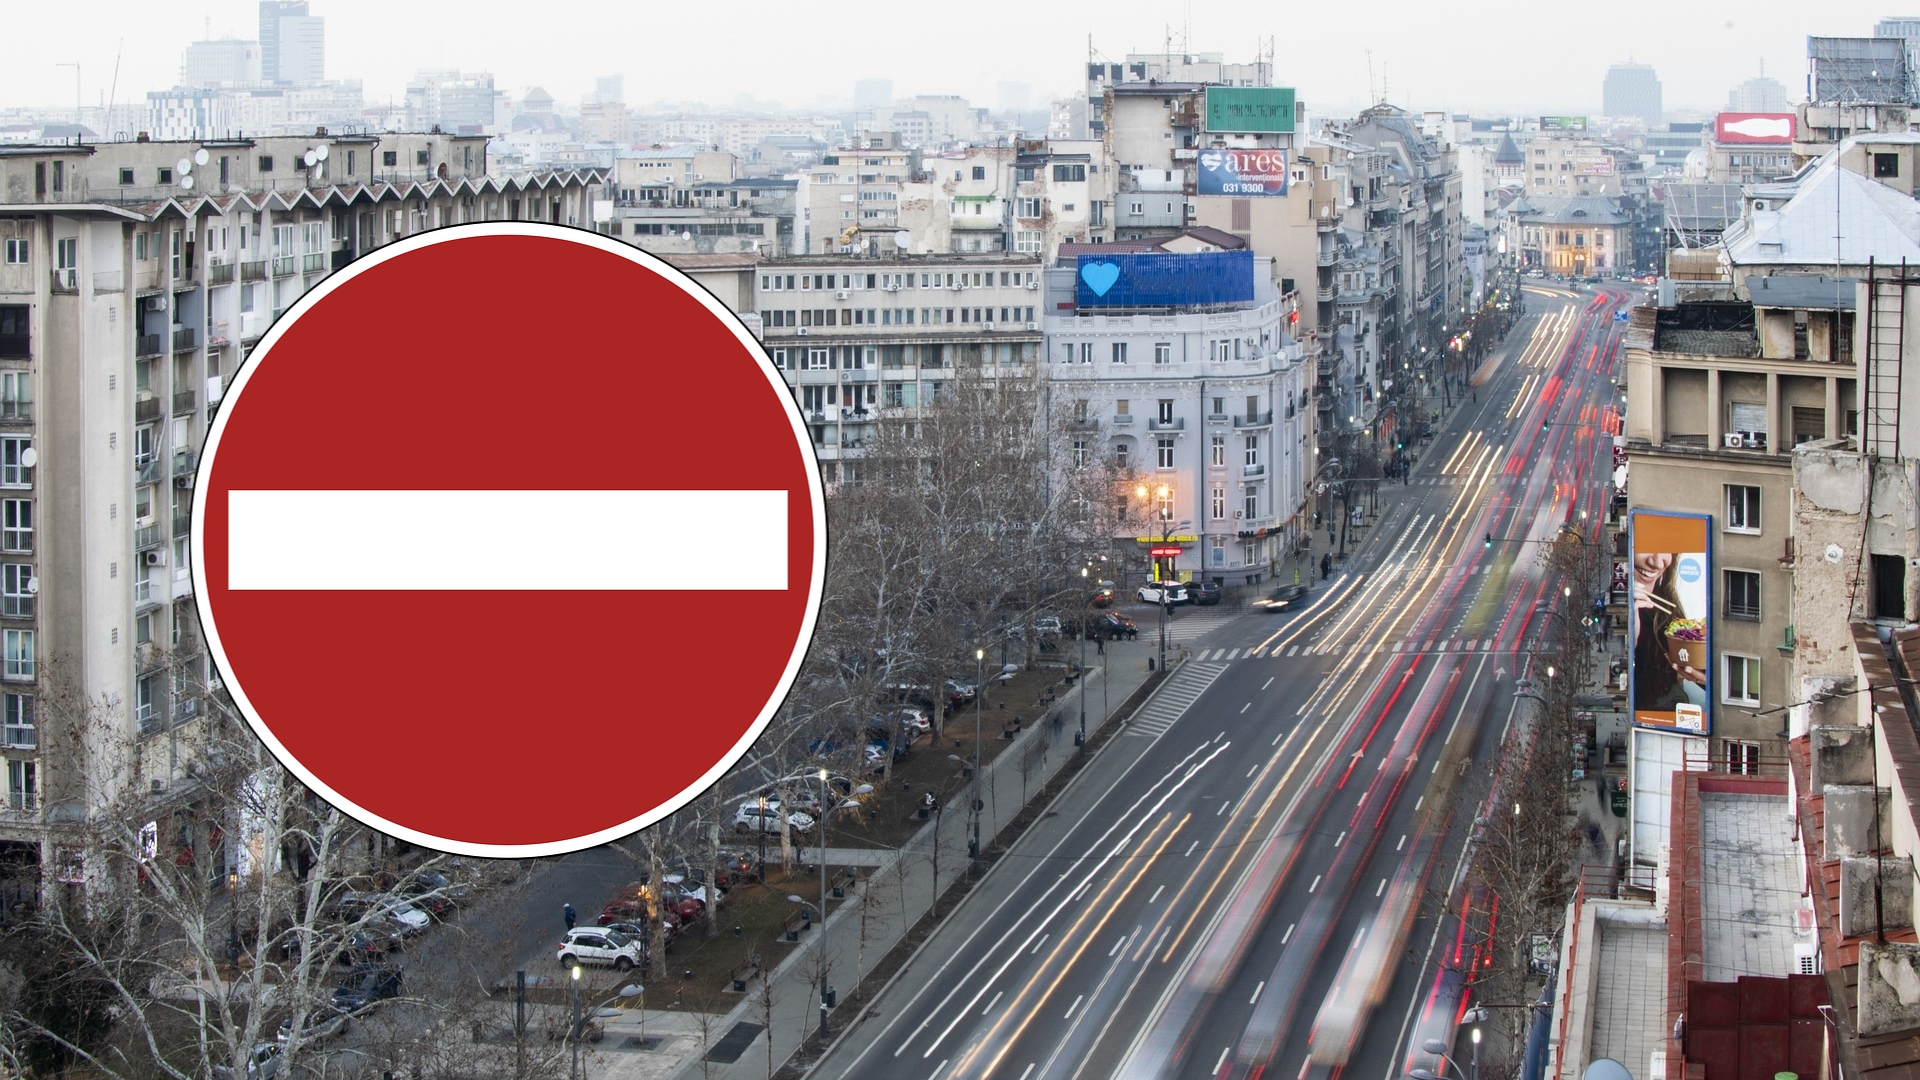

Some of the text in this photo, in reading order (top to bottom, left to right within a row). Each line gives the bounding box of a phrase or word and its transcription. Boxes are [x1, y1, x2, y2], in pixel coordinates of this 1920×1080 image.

[1224, 153, 1285, 172] ares
[1223, 183, 1264, 193] 031 9300
